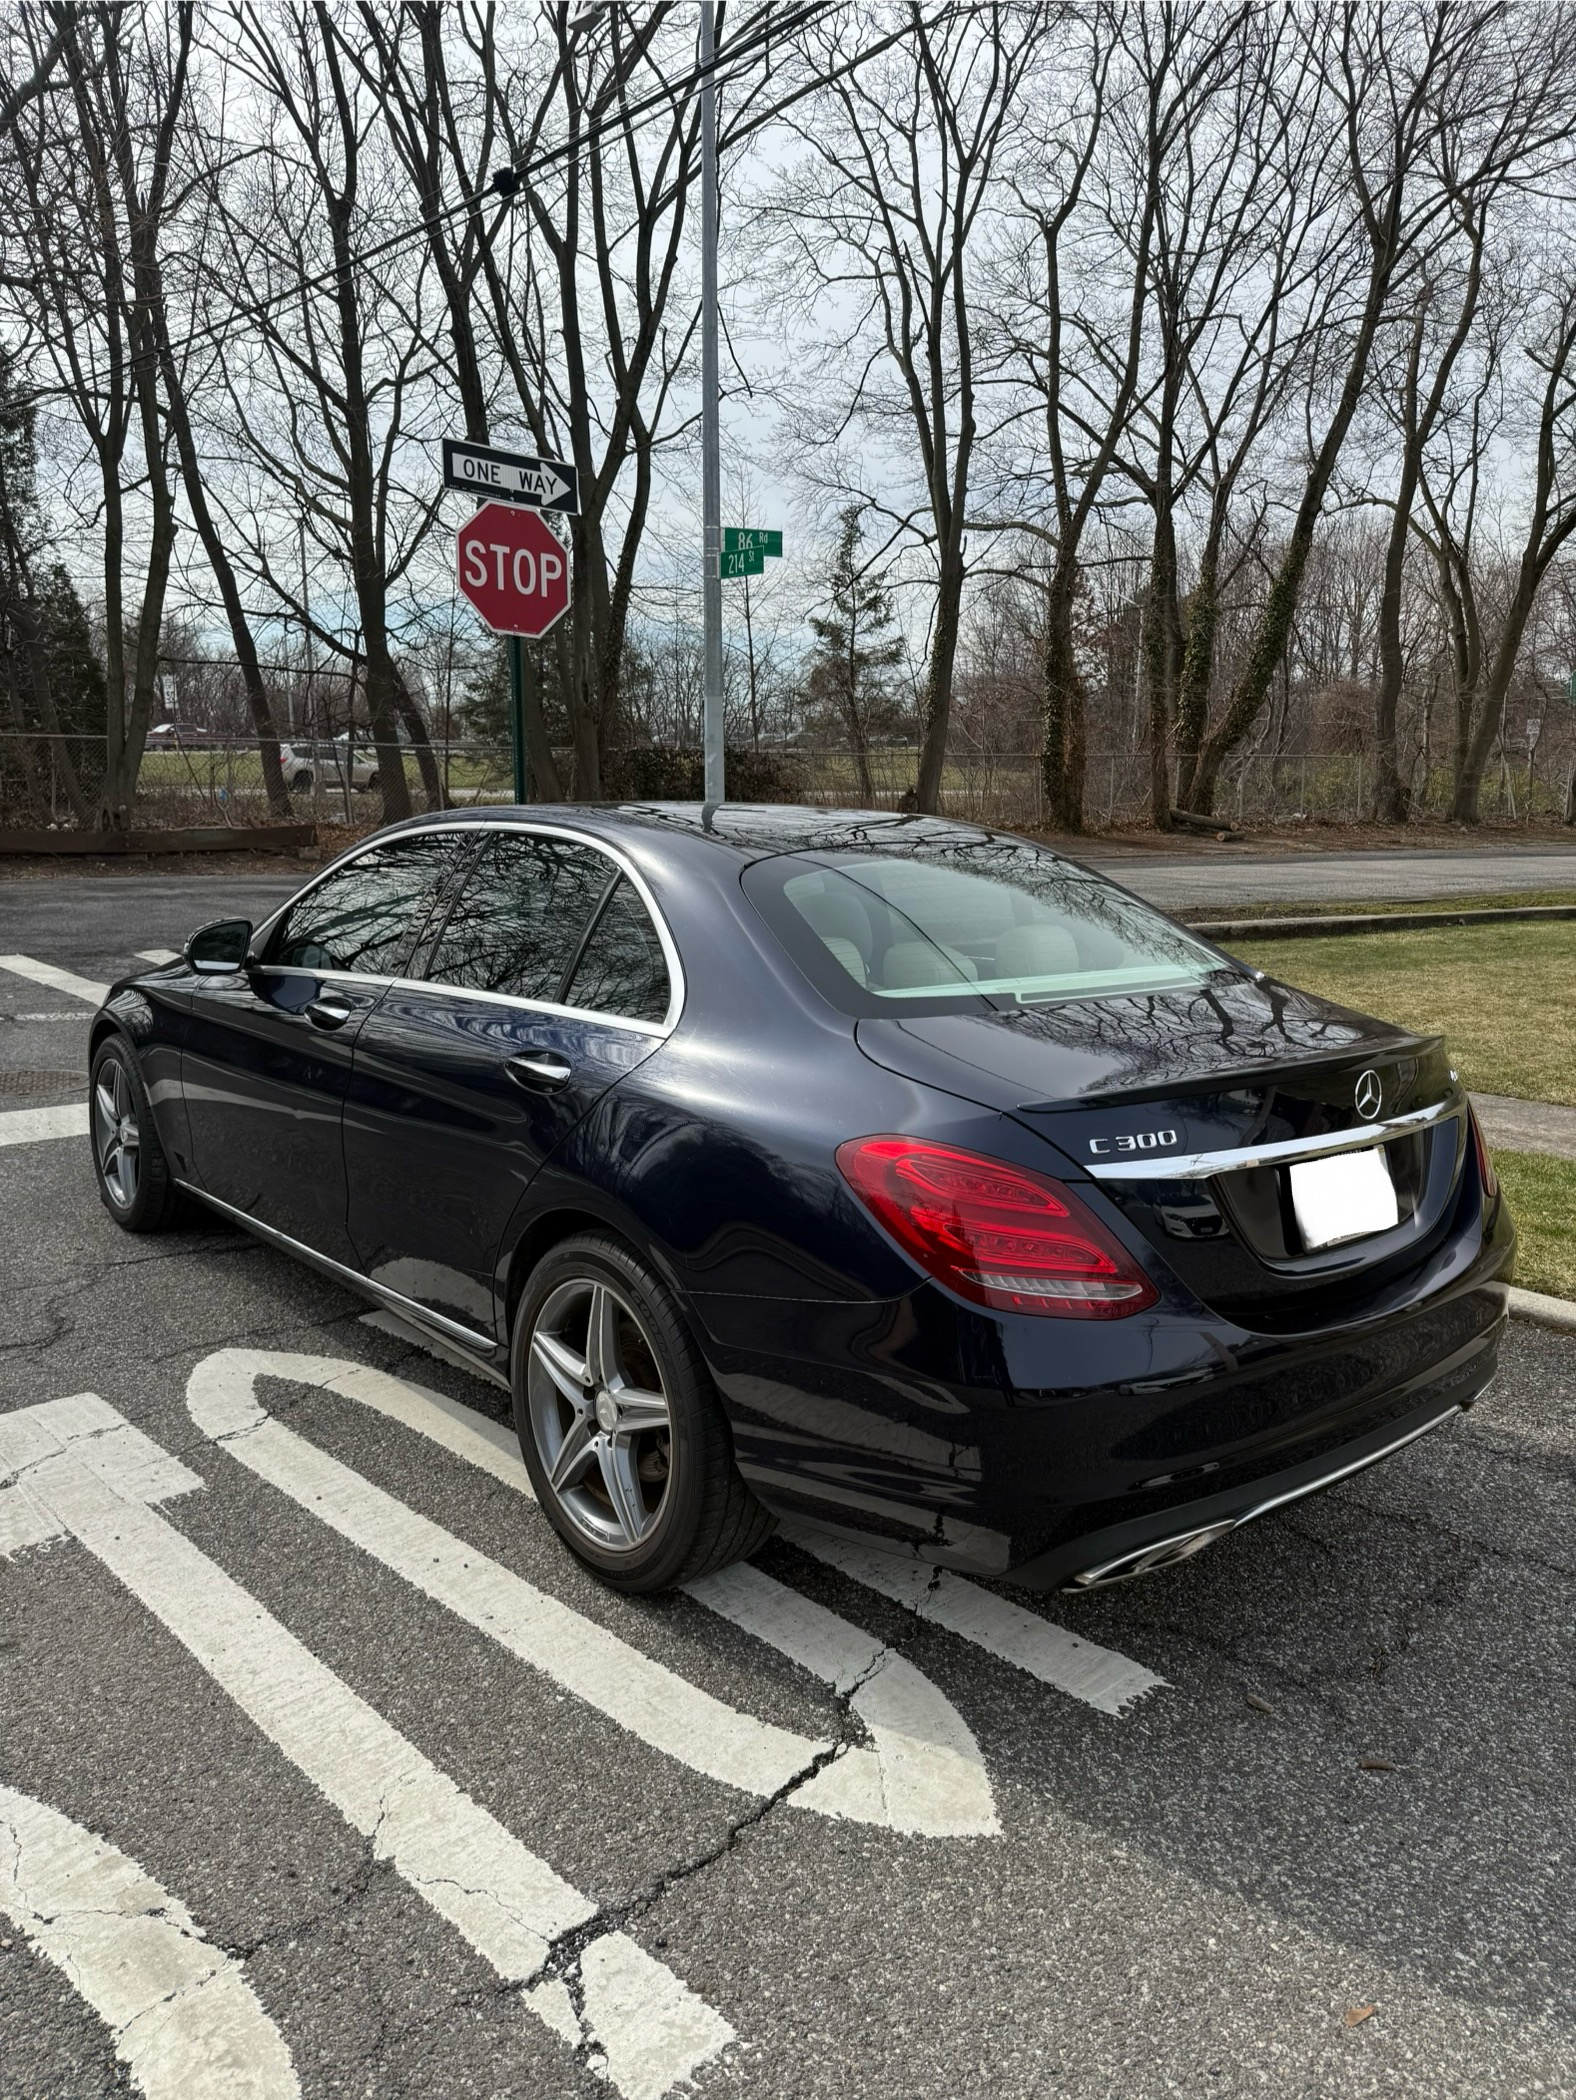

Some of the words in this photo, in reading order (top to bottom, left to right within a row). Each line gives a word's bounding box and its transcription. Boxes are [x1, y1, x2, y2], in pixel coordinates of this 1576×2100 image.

[463, 459, 501, 484] ONE
[519, 471, 557, 495] WAY
[738, 532, 753, 549] 86
[758, 532, 768, 544] Rd
[465, 540, 562, 597] STOP
[728, 553, 744, 574] 214
[748, 550, 755, 562] St
[1089, 1138, 1111, 1154] C
[1115, 1130, 1177, 1152] 300
